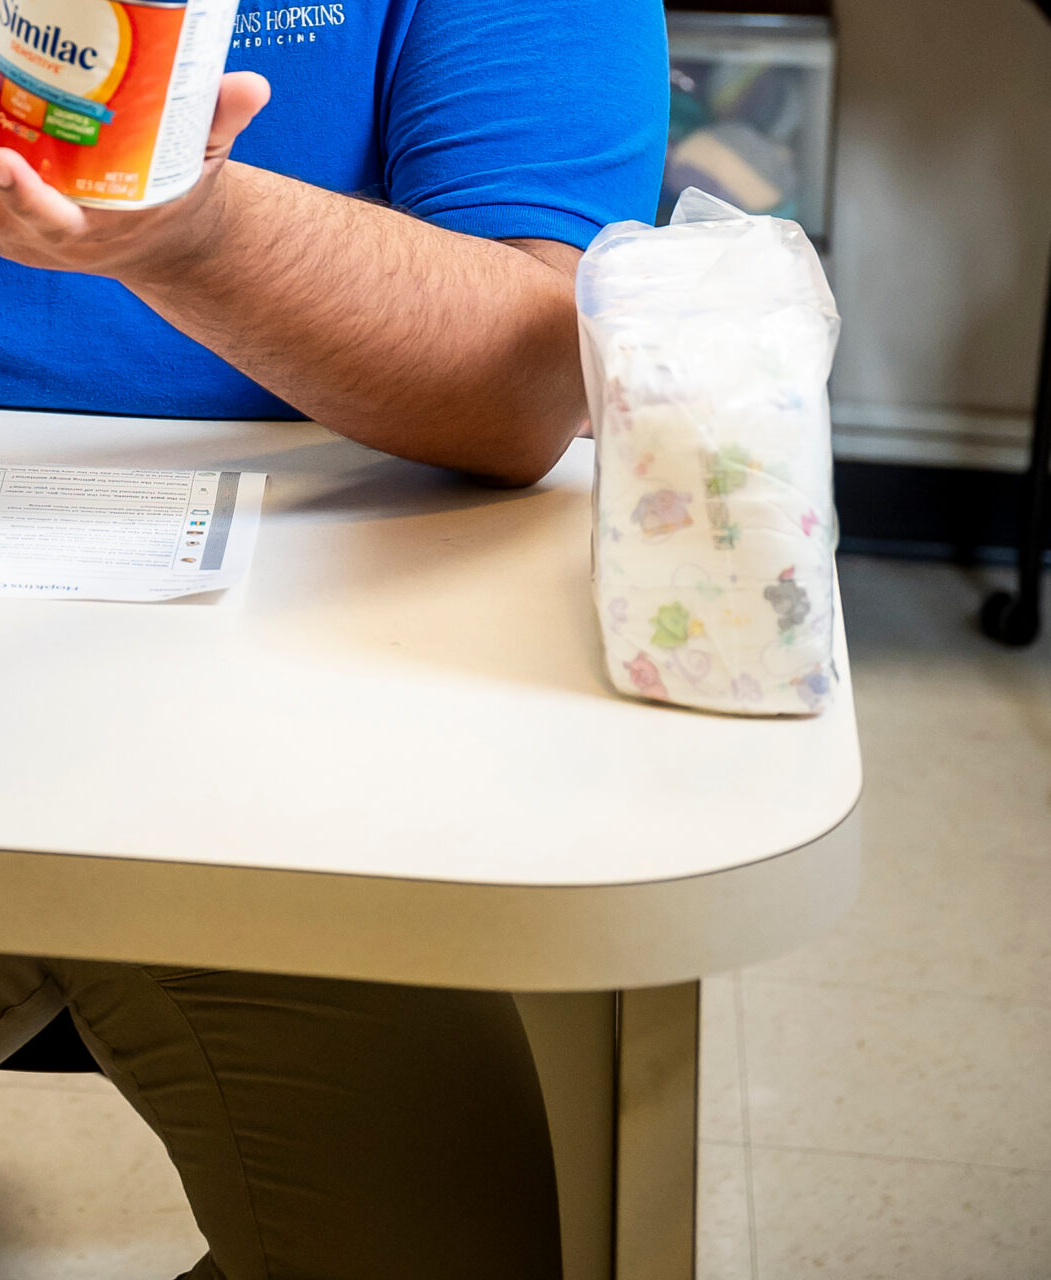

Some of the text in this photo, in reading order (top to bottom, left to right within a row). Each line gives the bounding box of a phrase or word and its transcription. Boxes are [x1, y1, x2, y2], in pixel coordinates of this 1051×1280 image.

[266, 3, 345, 30] HOPKINS
[233, 32, 316, 48] MEDICINE
[11, 583, 79, 591] Hopkins
